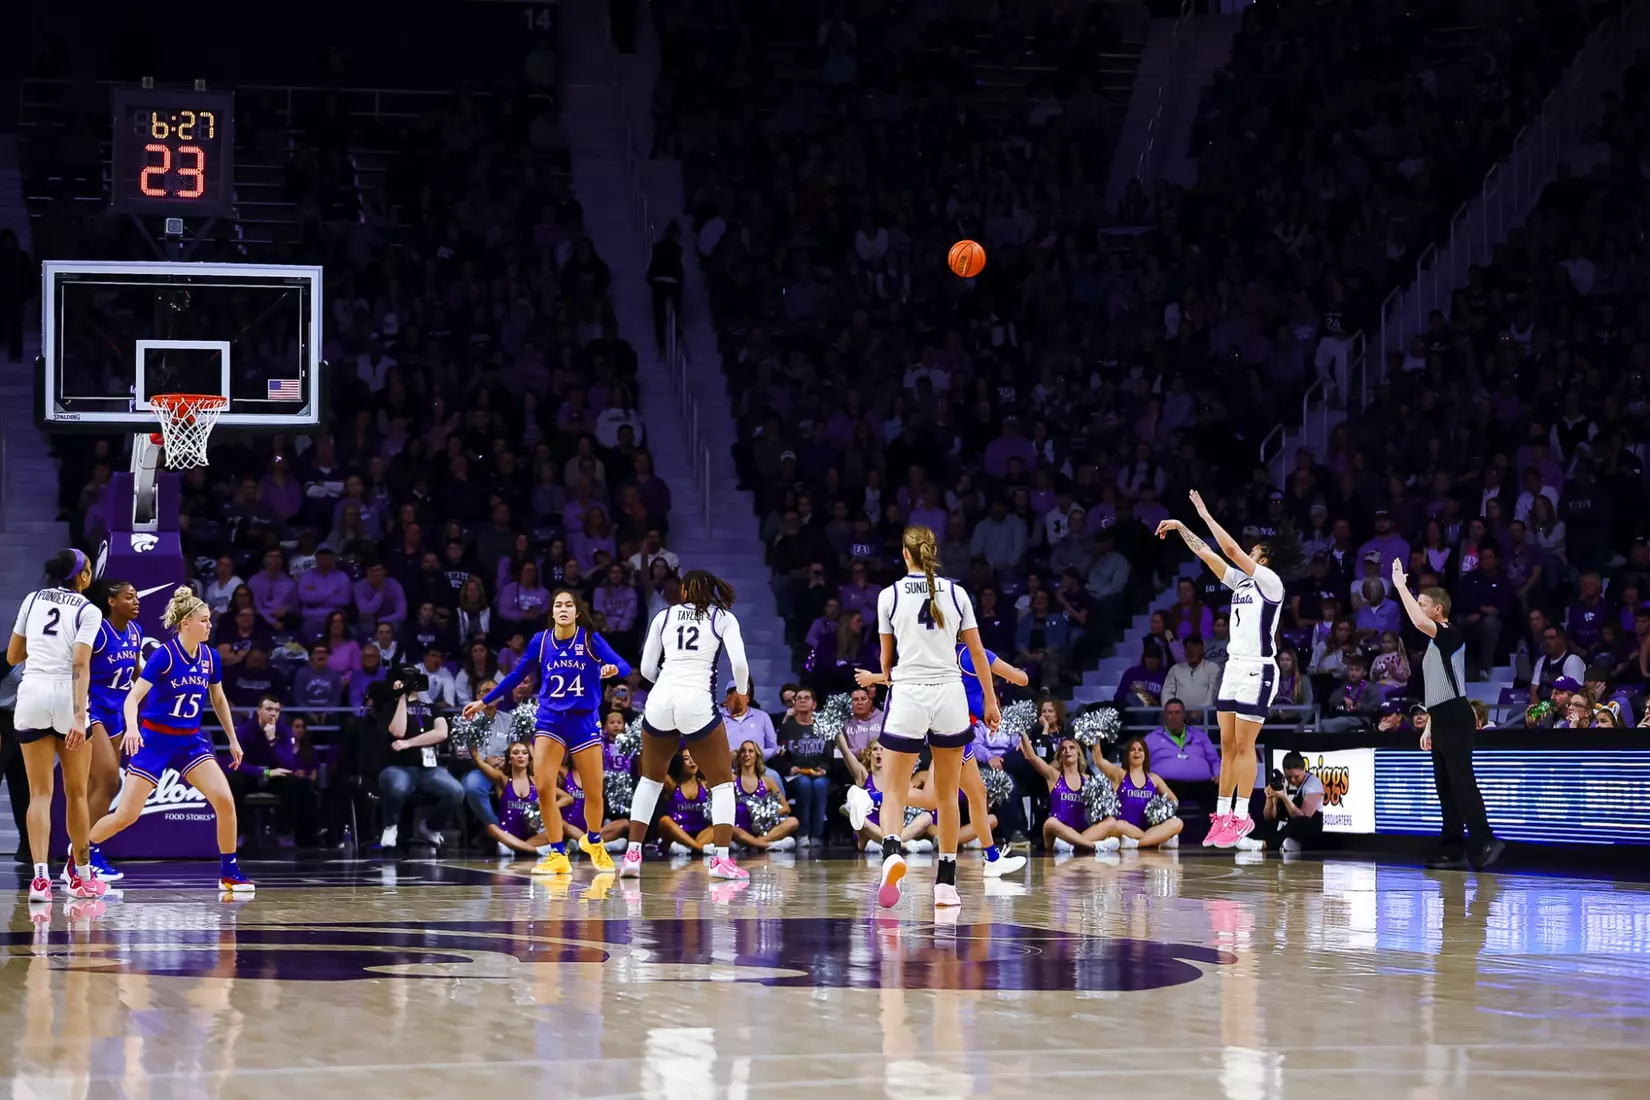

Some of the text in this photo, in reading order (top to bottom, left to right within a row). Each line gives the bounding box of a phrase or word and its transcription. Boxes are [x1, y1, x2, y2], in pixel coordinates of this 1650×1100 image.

[521, 7, 552, 31] 14
[152, 110, 215, 140] 6:27
[140, 144, 204, 198] 23
[53, 413, 81, 421] SPALDING
[37, 590, 83, 608] POINDEXTER
[904, 581, 945, 595] SUNDL
[42, 607, 61, 637] 2
[917, 598, 936, 631] 4
[1235, 607, 1241, 628] 1
[676, 625, 700, 651] 12
[546, 659, 587, 672] KANSAS
[106, 666, 135, 691] 12
[550, 674, 585, 698] 24
[168, 693, 202, 718] 15
[165, 813, 185, 821] FOOD
